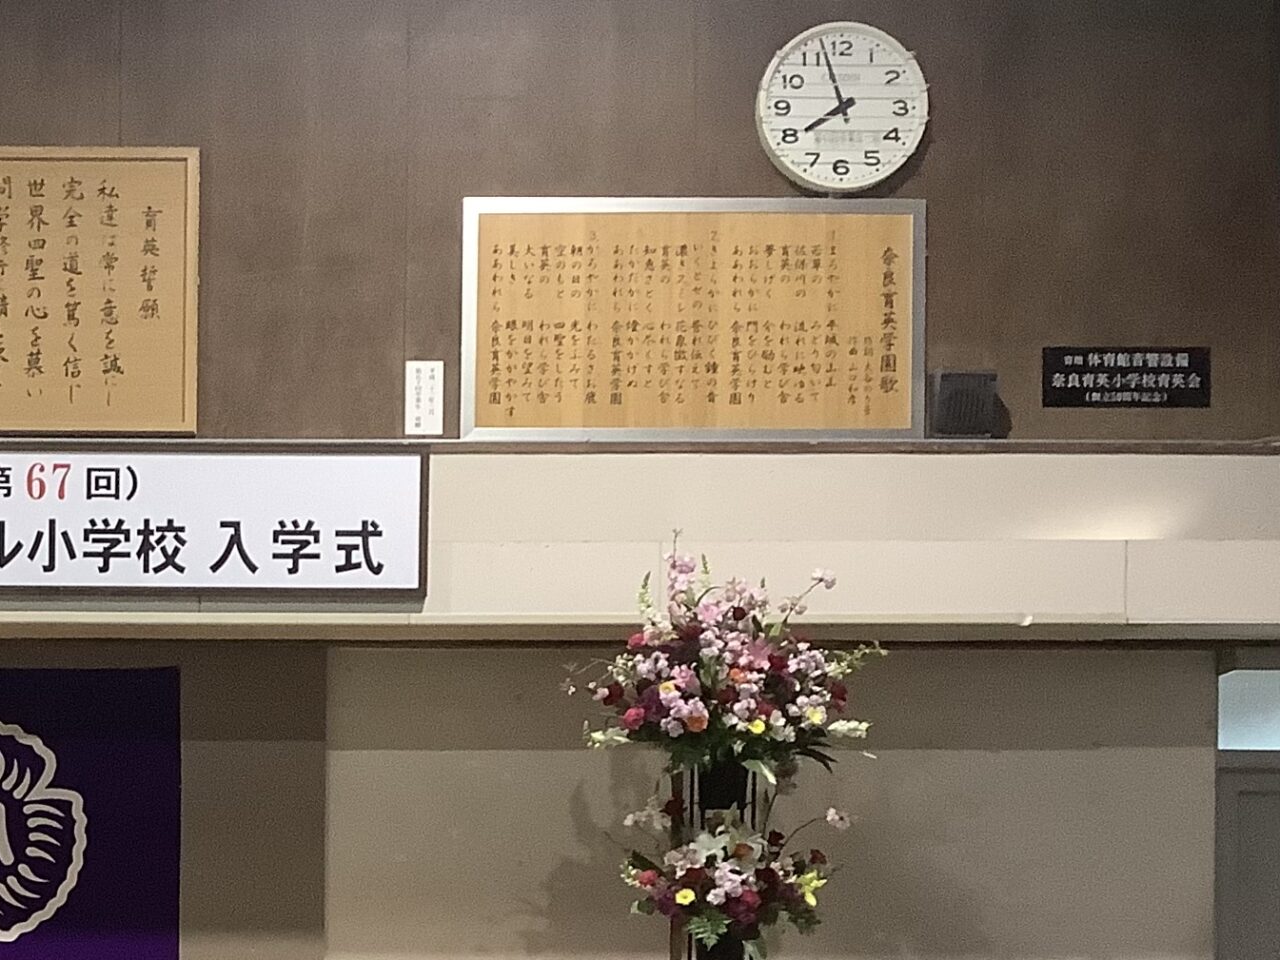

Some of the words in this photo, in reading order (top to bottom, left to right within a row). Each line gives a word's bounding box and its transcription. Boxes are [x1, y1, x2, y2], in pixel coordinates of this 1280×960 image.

[832, 41, 852, 56] 12
[869, 48, 874, 64] 1
[803, 52, 819, 66] 11
[782, 75, 804, 89] 10
[885, 70, 901, 85] 2
[774, 100, 790, 116] 9
[893, 100, 908, 116] 3
[782, 128, 798, 143] 8
[883, 128, 900, 142] 4
[805, 152, 820, 168] 7
[865, 151, 880, 166] 5
[833, 160, 849, 175] 6
[139, 206, 162, 319] 育英誓願
[1051, 372, 1201, 389] 奈良育英小学校育英会
[210, 520, 384, 576] 入学式
